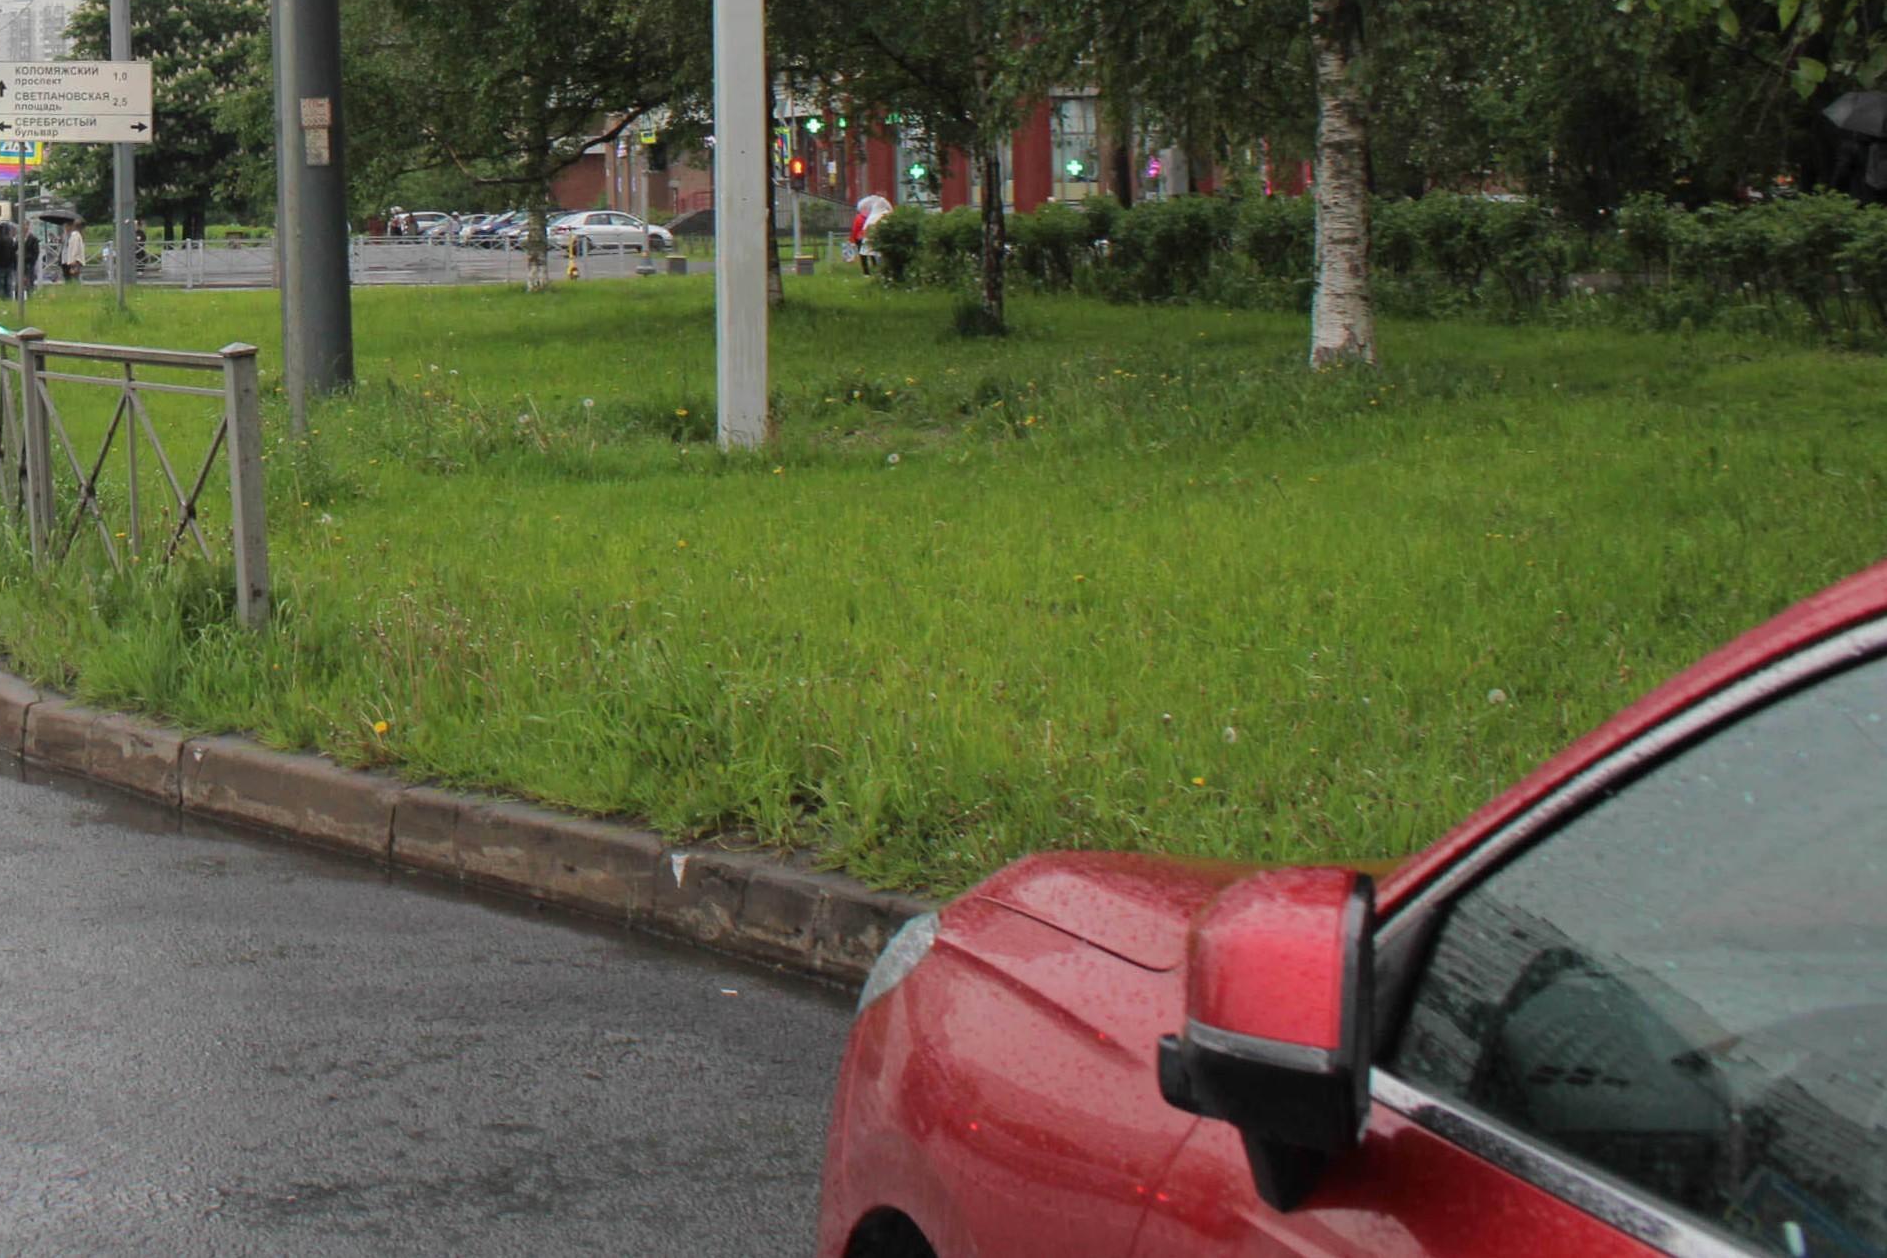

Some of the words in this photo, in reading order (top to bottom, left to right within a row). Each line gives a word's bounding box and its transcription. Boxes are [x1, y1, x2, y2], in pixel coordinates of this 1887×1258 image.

[14, 77, 62, 86] проспект
[14, 92, 111, 101] СВЕТЛАНОВСКАЯ
[14, 103, 63, 112] площадь
[14, 128, 59, 138] бульвар
